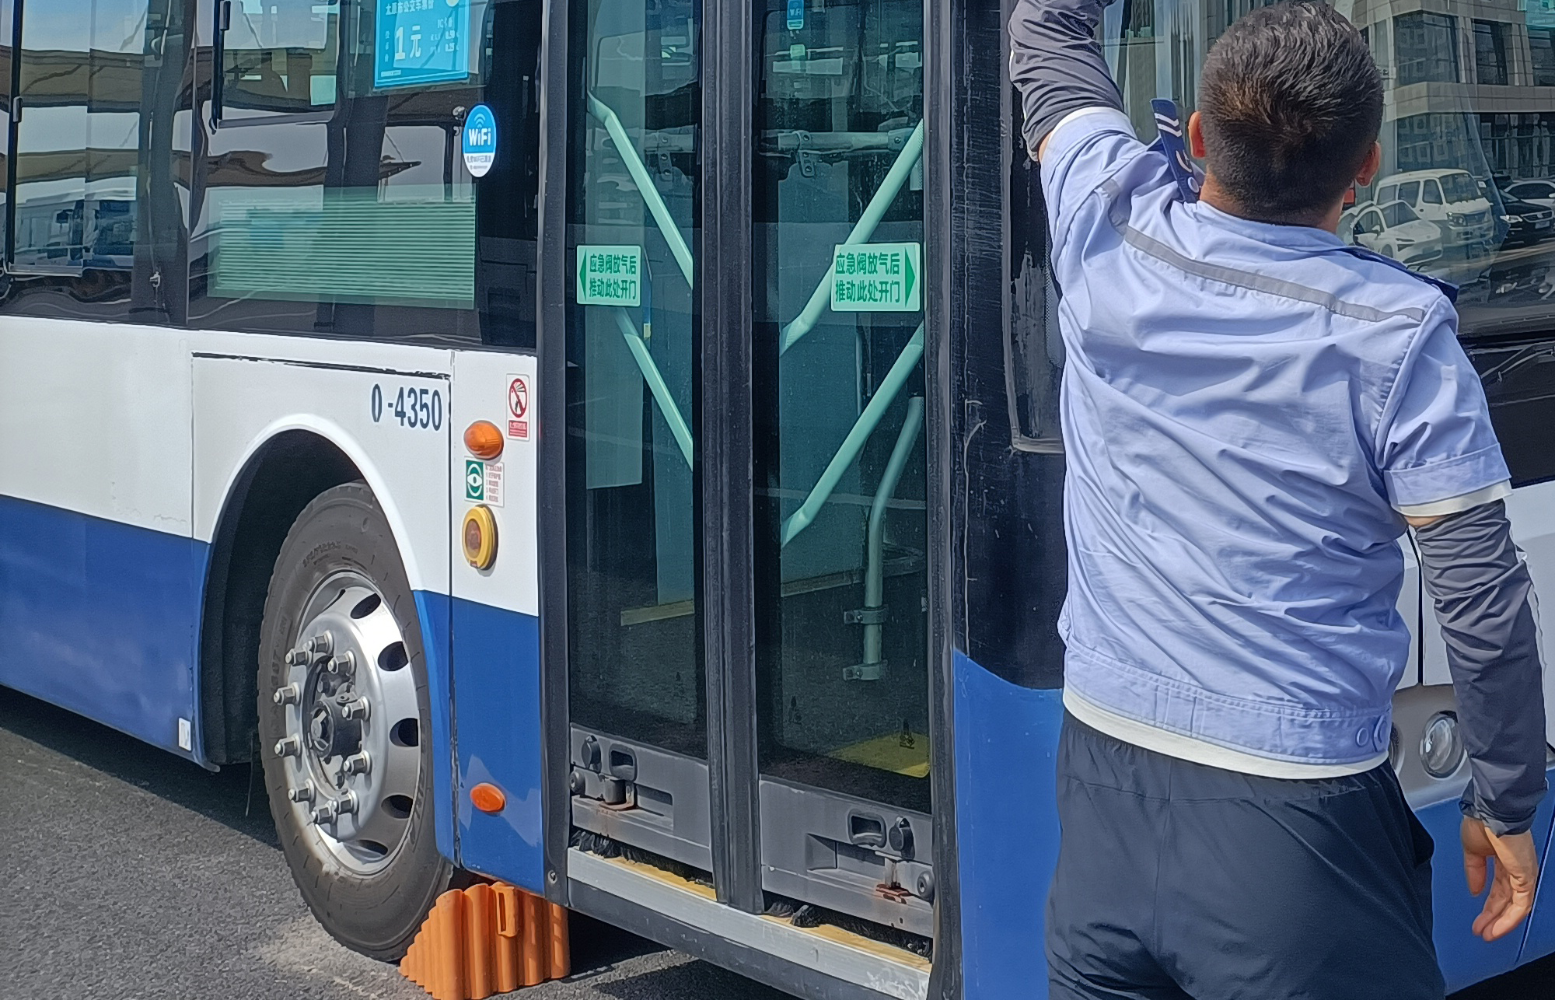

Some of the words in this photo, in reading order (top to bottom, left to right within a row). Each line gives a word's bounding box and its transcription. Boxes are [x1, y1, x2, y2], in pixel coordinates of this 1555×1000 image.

[468, 127, 492, 147] WiFi
[589, 252, 637, 275] 应急阀放气后
[835, 251, 901, 275] 应急阀放气后
[588, 276, 637, 300] 推动此处开门
[835, 279, 901, 304] 推动此处开门
